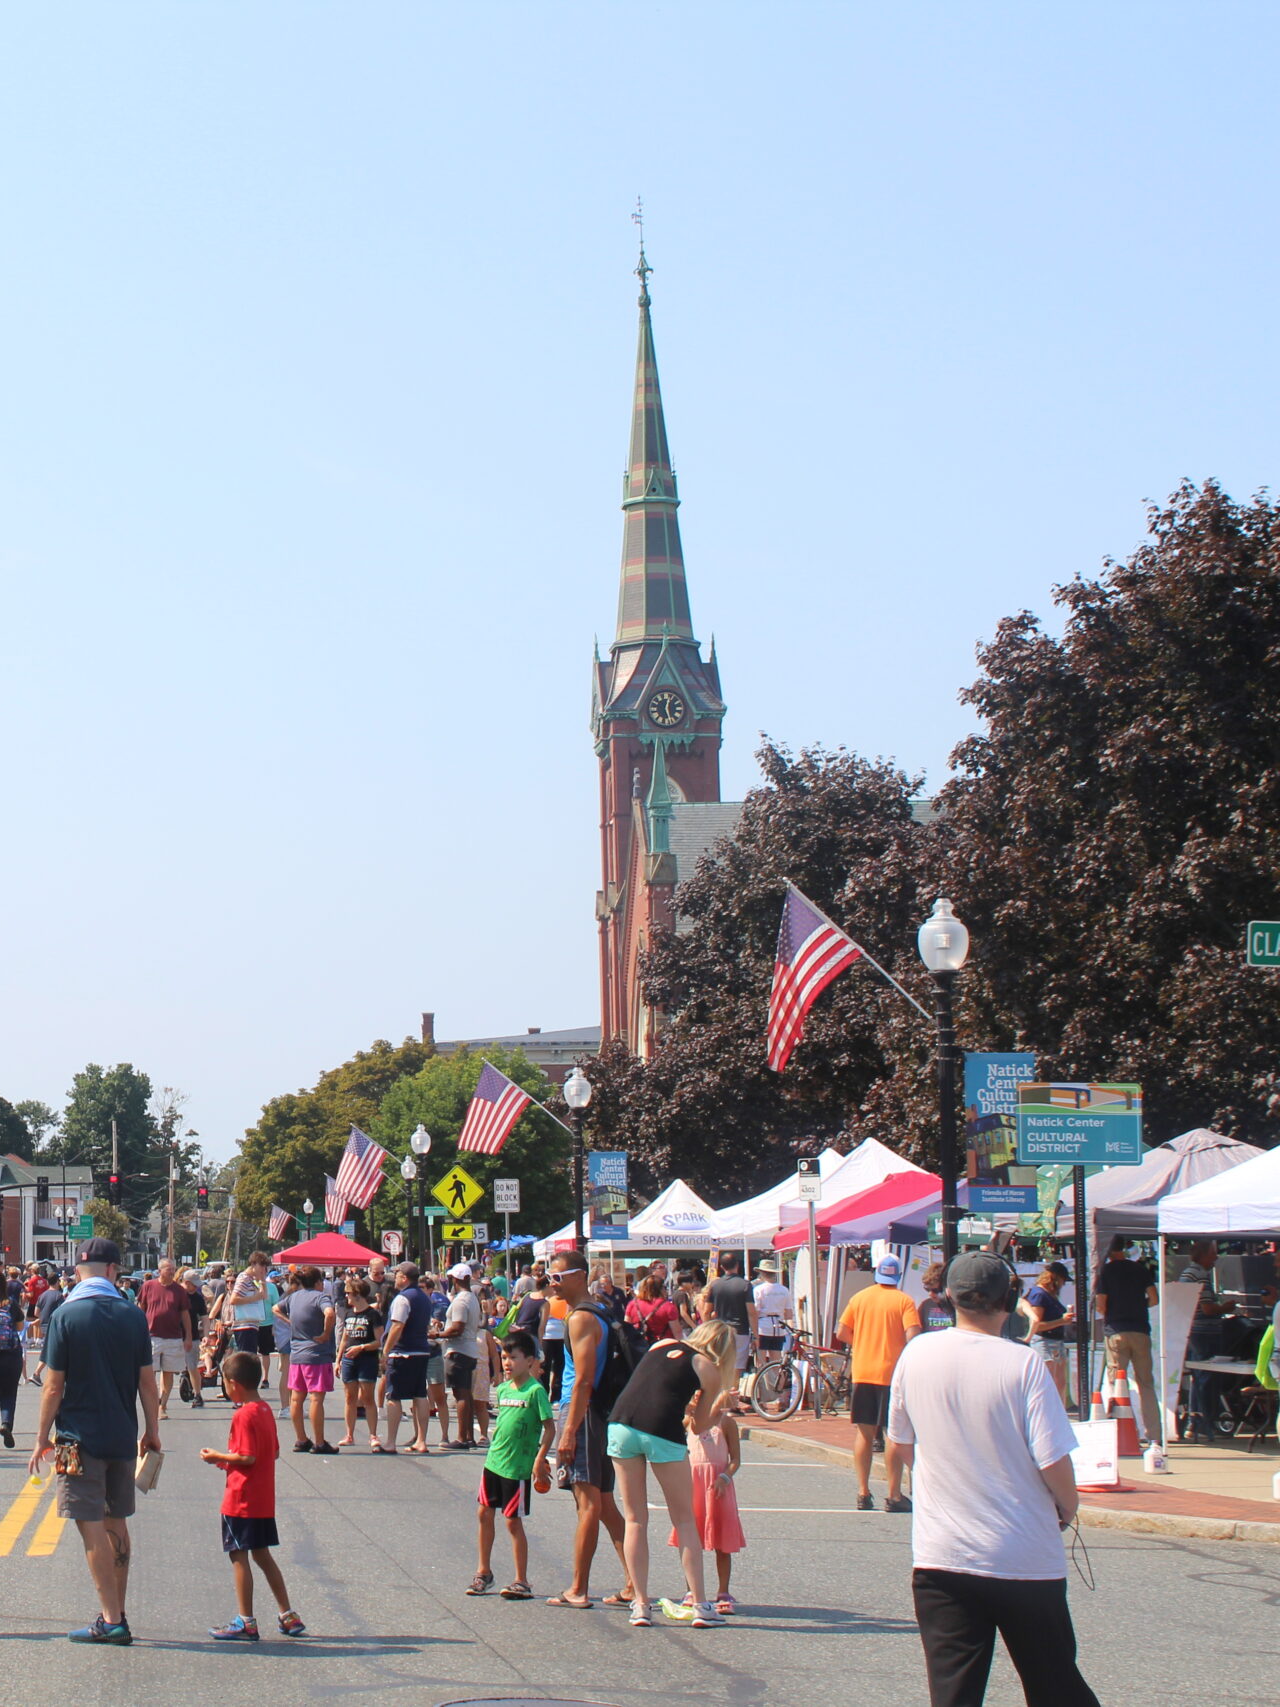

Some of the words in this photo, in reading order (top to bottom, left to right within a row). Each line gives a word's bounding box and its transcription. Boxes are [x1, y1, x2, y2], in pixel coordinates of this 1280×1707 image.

[987, 1064, 1033, 1077] Natick
[986, 1077, 1033, 1089] Cent
[977, 1089, 1017, 1101] Cultu
[981, 1102, 1016, 1114] Distr
[1027, 1117, 1064, 1127] Natick
[1066, 1117, 1105, 1127] Center
[1027, 1132, 1088, 1142] CULTURAL
[1027, 1143, 1081, 1153] DISTRICT
[600, 1157, 627, 1166] Natick
[600, 1165, 627, 1173] Center
[594, 1171, 626, 1180] Cultural
[505, 1183, 517, 1191] NOT
[597, 1179, 626, 1187] District
[496, 1194, 518, 1202] BLOCK
[662, 1212, 708, 1227] SPARK
[642, 1234, 745, 1247] SPARKKindnss.or
